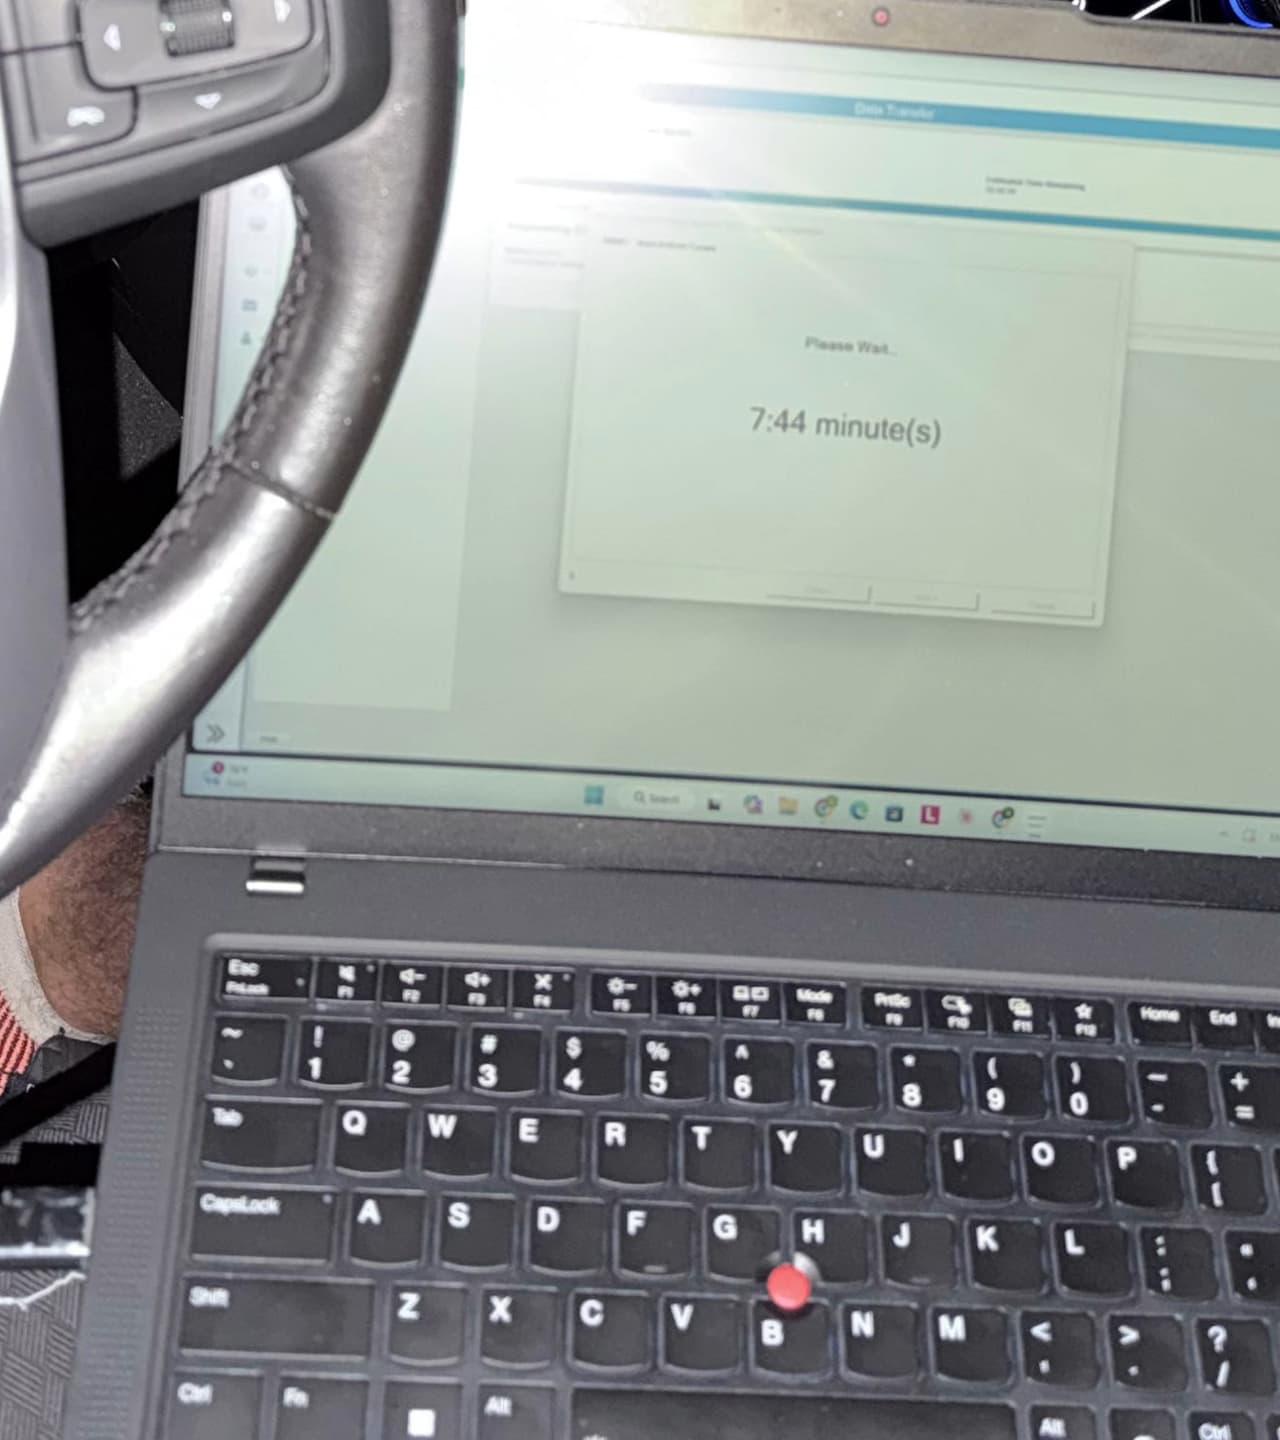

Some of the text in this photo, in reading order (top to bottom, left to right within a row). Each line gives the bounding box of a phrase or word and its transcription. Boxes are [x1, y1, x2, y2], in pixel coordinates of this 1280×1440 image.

[804, 336, 855, 353] Please
[750, 406, 942, 449] 7:44 minute(s)
[228, 958, 259, 977] Esc
[1140, 1006, 1180, 1023] Home
[1208, 1008, 1238, 1027] End
[391, 1029, 416, 1052] @
[480, 1034, 498, 1054] #
[566, 1036, 582, 1059] $
[646, 1040, 670, 1062] %
[308, 1056, 322, 1080] 1
[391, 1059, 411, 1084] 2
[816, 1049, 834, 1069] &
[477, 1063, 498, 1088] 3
[563, 1067, 583, 1091] 4
[649, 1070, 668, 1095] 5
[733, 1074, 753, 1099] 6
[818, 1078, 836, 1103] 7
[902, 1083, 922, 1107] 8
[986, 1087, 1005, 1111] 9
[1069, 1091, 1089, 1116] 0
[212, 1107, 243, 1127] Tab
[342, 1109, 367, 1136] Q
[427, 1113, 457, 1139] W
[518, 1117, 539, 1143] E
[604, 1121, 626, 1146] R
[691, 1125, 712, 1150] T
[776, 1129, 798, 1154] Y
[863, 1133, 885, 1159] U
[1031, 1141, 1055, 1167] O
[1117, 1146, 1137, 1170] P
[199, 1193, 280, 1215] CapsLock
[357, 1198, 381, 1225] A
[447, 1201, 470, 1228] S
[537, 1206, 560, 1232] D
[627, 1210, 646, 1235] F
[713, 1214, 738, 1240] G
[802, 1218, 825, 1244] H
[892, 1222, 911, 1248] J
[976, 1225, 999, 1251] K
[1064, 1229, 1085, 1255] L
[189, 1286, 230, 1307] Shift
[397, 1292, 420, 1320] Z
[489, 1295, 512, 1323] X
[579, 1299, 604, 1327] C
[670, 1303, 694, 1330] V
[851, 1310, 875, 1338] N
[761, 1319, 784, 1346] B
[938, 1314, 966, 1341] M
[1207, 1325, 1228, 1352] ?
[177, 1382, 213, 1403] Ctrl
[283, 1387, 309, 1407] Fn
[484, 1396, 512, 1415] Alt
[1039, 1417, 1066, 1438] Alt
[1199, 1423, 1231, 1440] Ctrl
